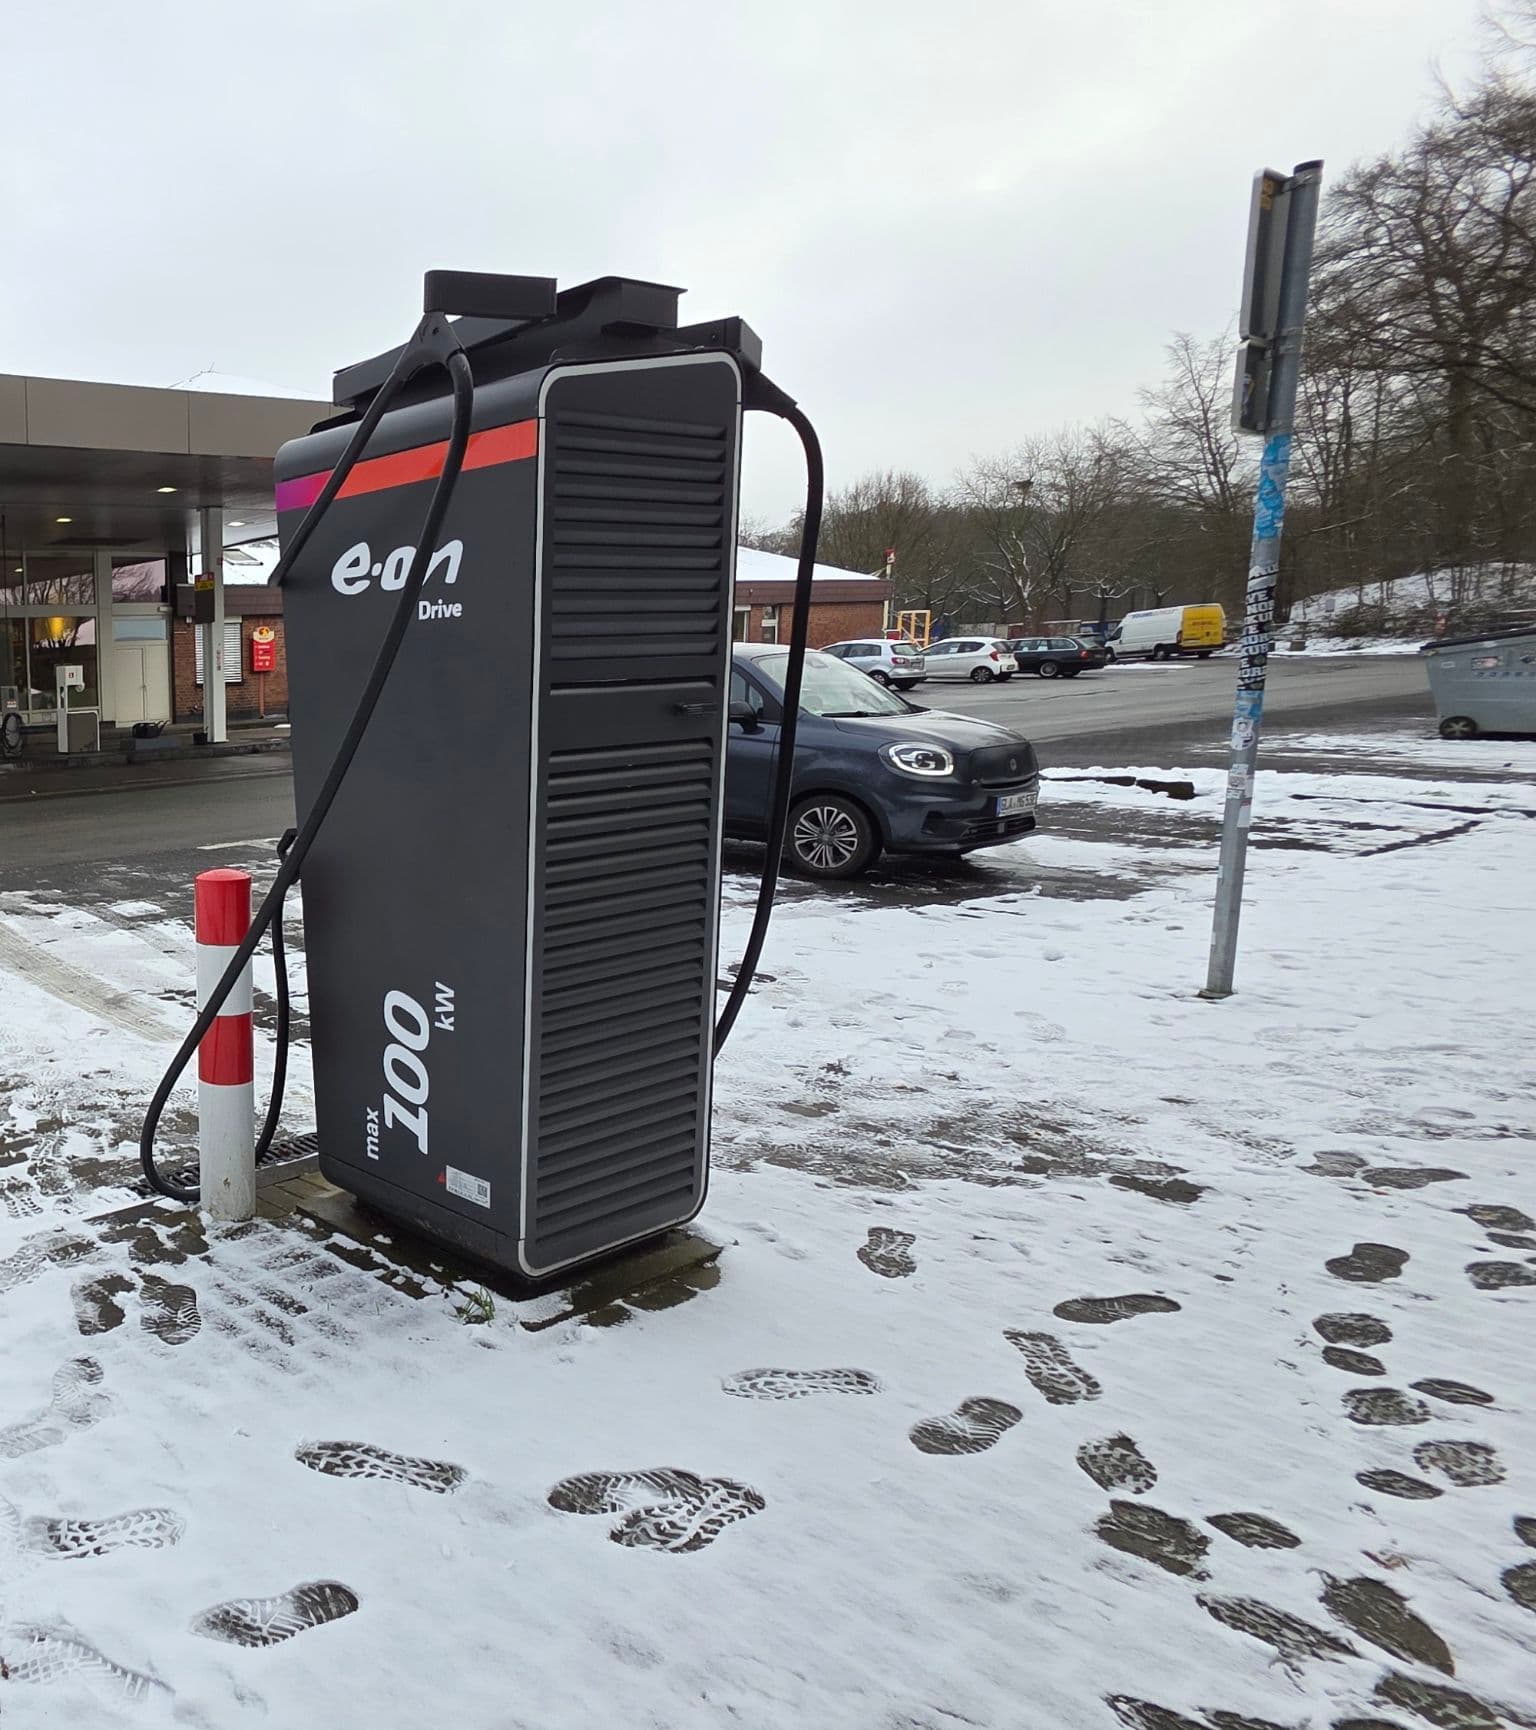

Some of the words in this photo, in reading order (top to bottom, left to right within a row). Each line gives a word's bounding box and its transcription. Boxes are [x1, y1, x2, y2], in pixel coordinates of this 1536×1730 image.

[418, 598, 463, 621] Drive
[434, 981, 455, 1032] kW
[383, 990, 430, 1155] 100
[366, 1106, 379, 1160] max
